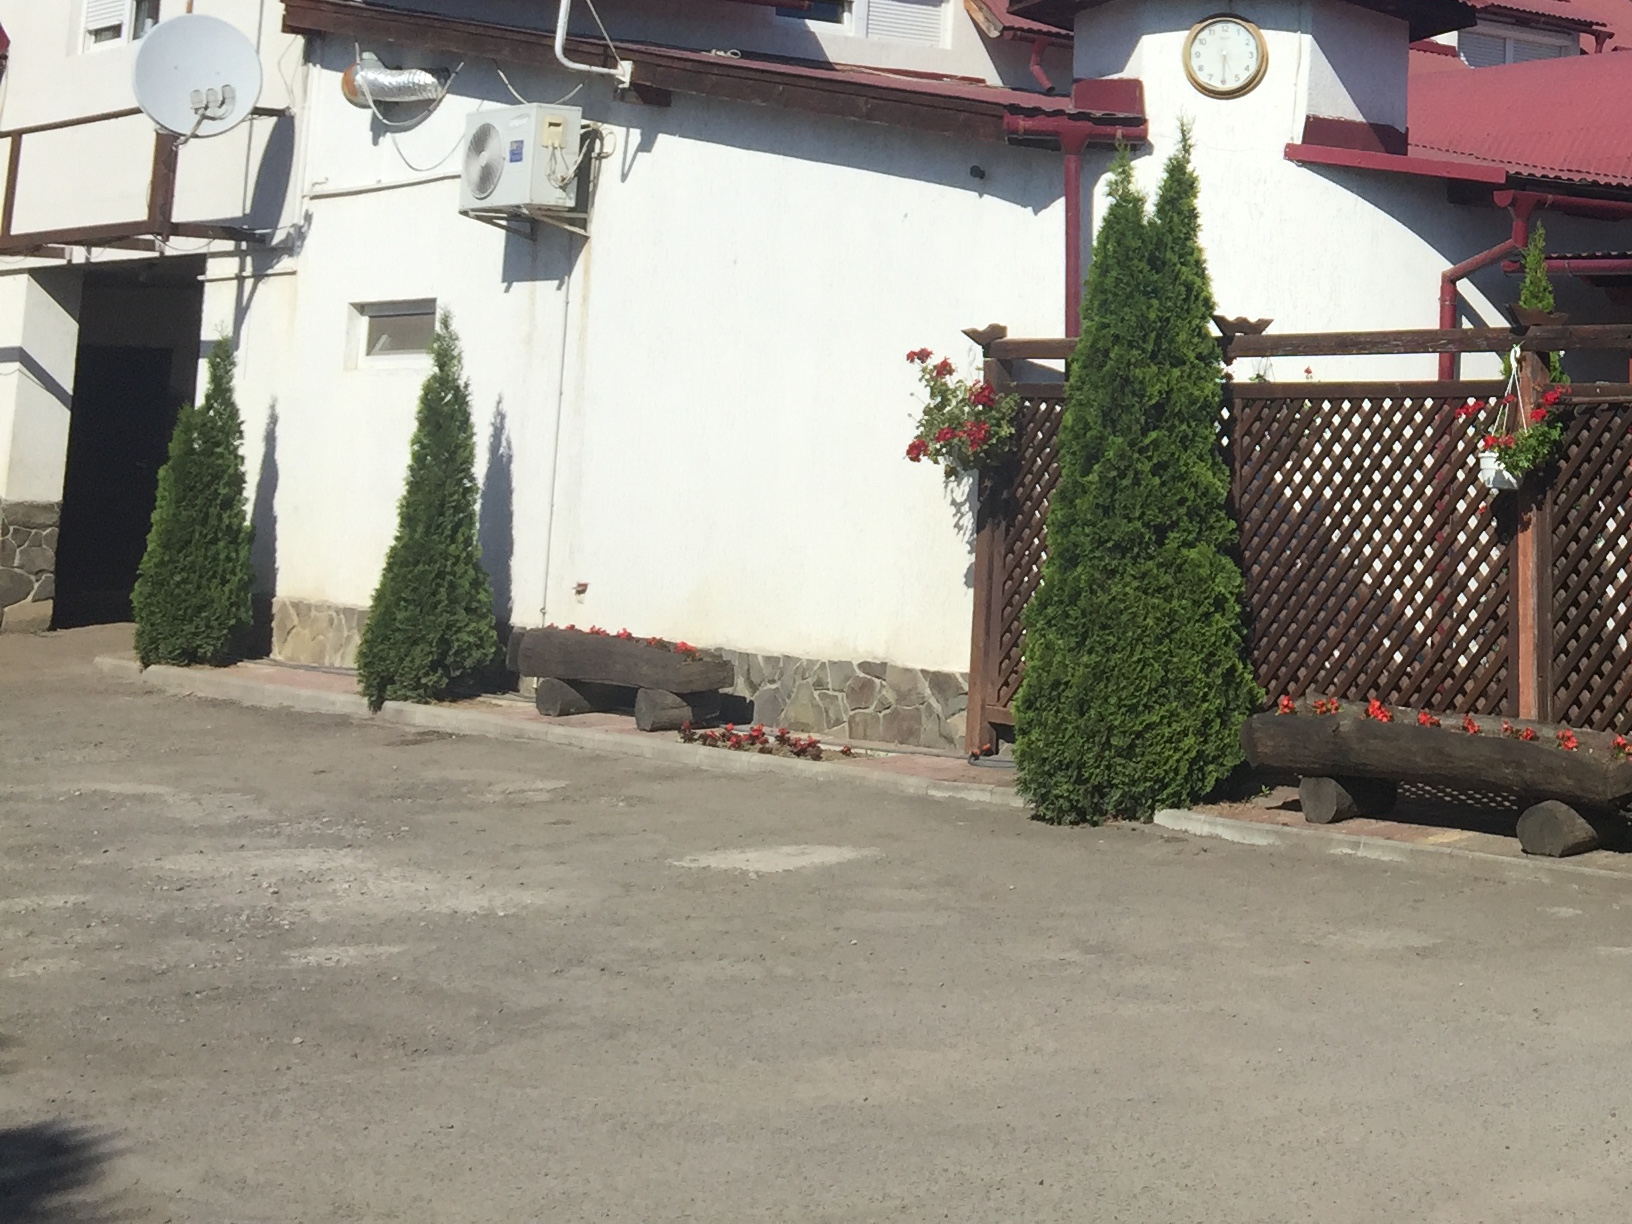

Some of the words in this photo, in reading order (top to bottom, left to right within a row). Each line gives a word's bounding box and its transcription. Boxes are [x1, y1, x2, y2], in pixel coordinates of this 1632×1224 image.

[1208, 28, 1216, 36] 11
[1221, 25, 1230, 33] 12
[1199, 38, 1207, 46] 10
[1245, 38, 1251, 46] 2
[1194, 51, 1201, 59] 9
[1249, 51, 1254, 59] 3
[1244, 64, 1250, 72] 4
[1207, 73, 1214, 81] 7
[1234, 74, 1240, 82] 5
[1220, 78, 1227, 86] 6
